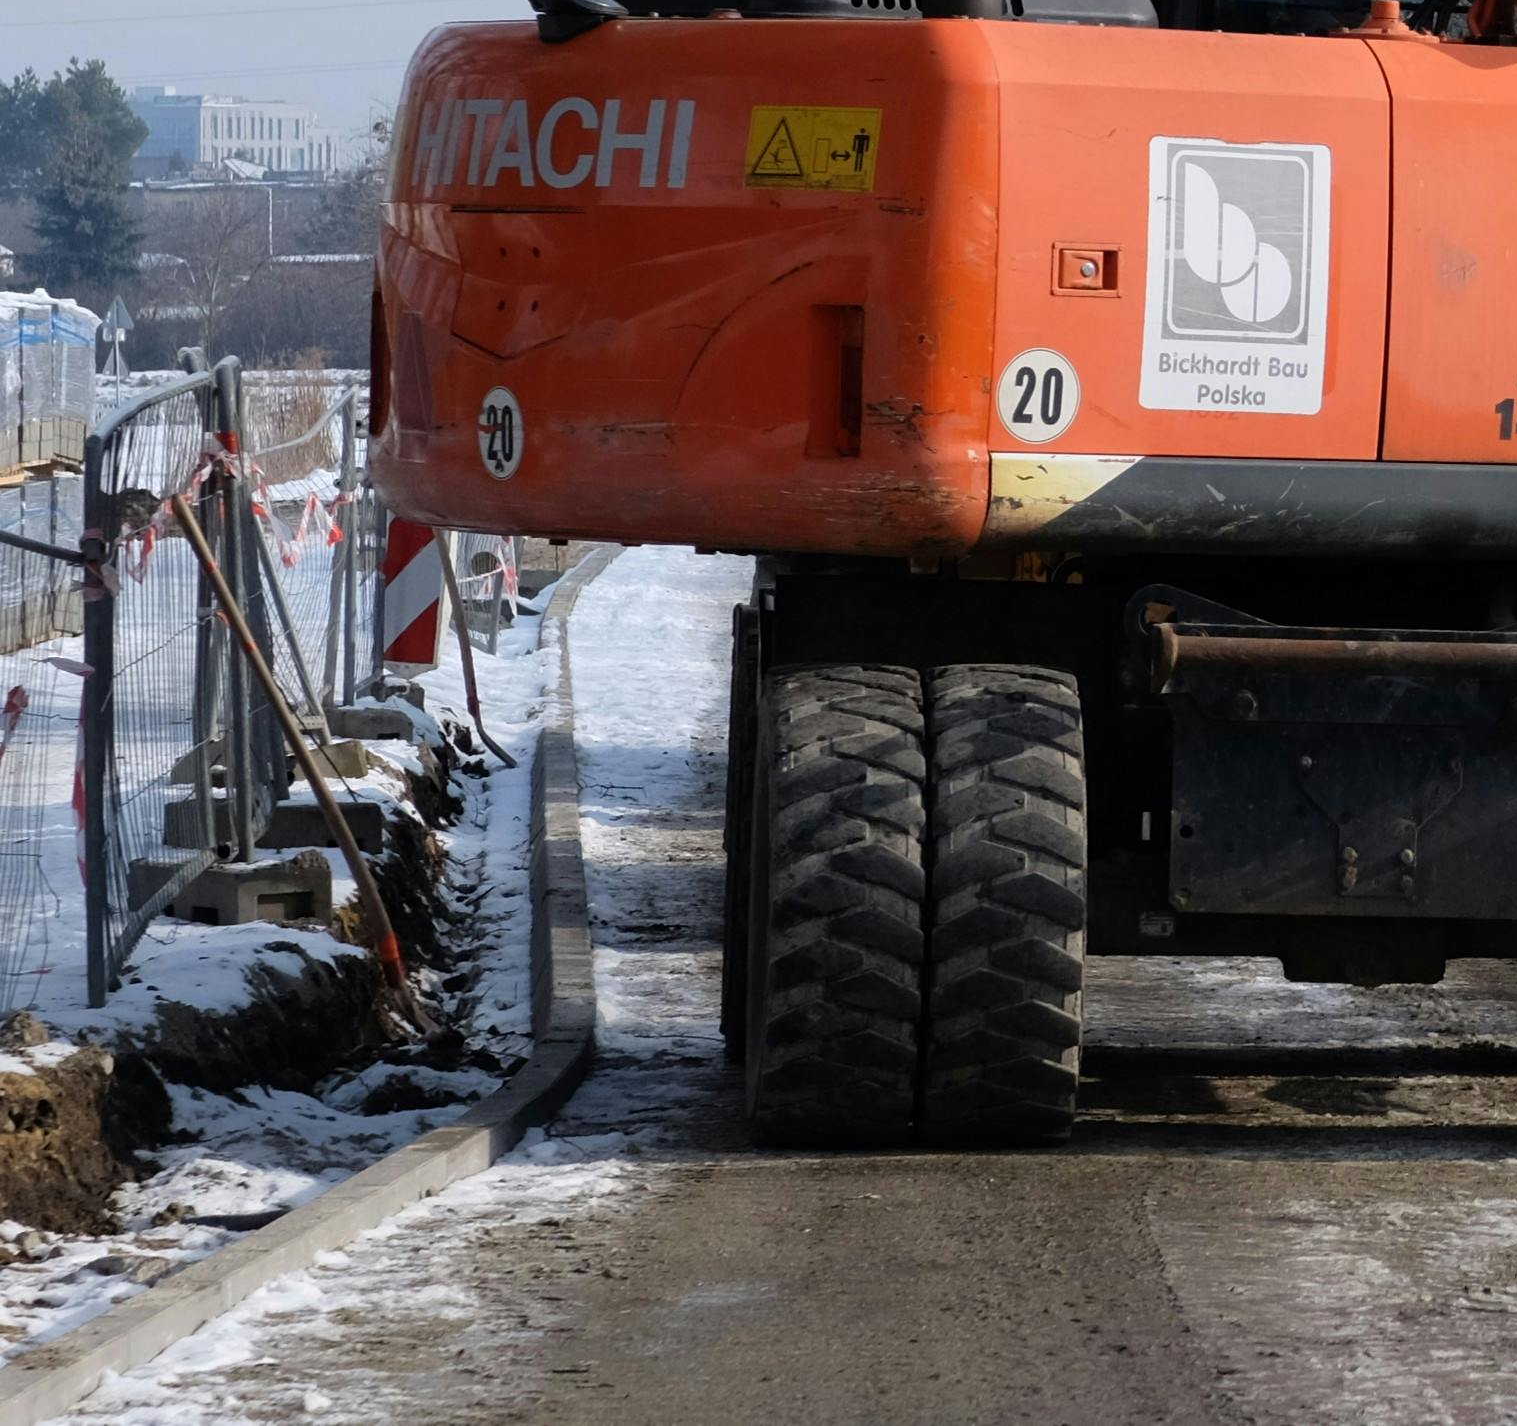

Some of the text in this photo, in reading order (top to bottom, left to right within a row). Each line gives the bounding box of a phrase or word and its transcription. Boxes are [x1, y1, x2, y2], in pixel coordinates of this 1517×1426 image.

[411, 97, 696, 189] HITACHI
[1158, 352, 1308, 378] Bickhardt Bau
[1012, 366, 1064, 425] 20
[1197, 384, 1266, 406] Polska
[486, 404, 513, 462] 20
